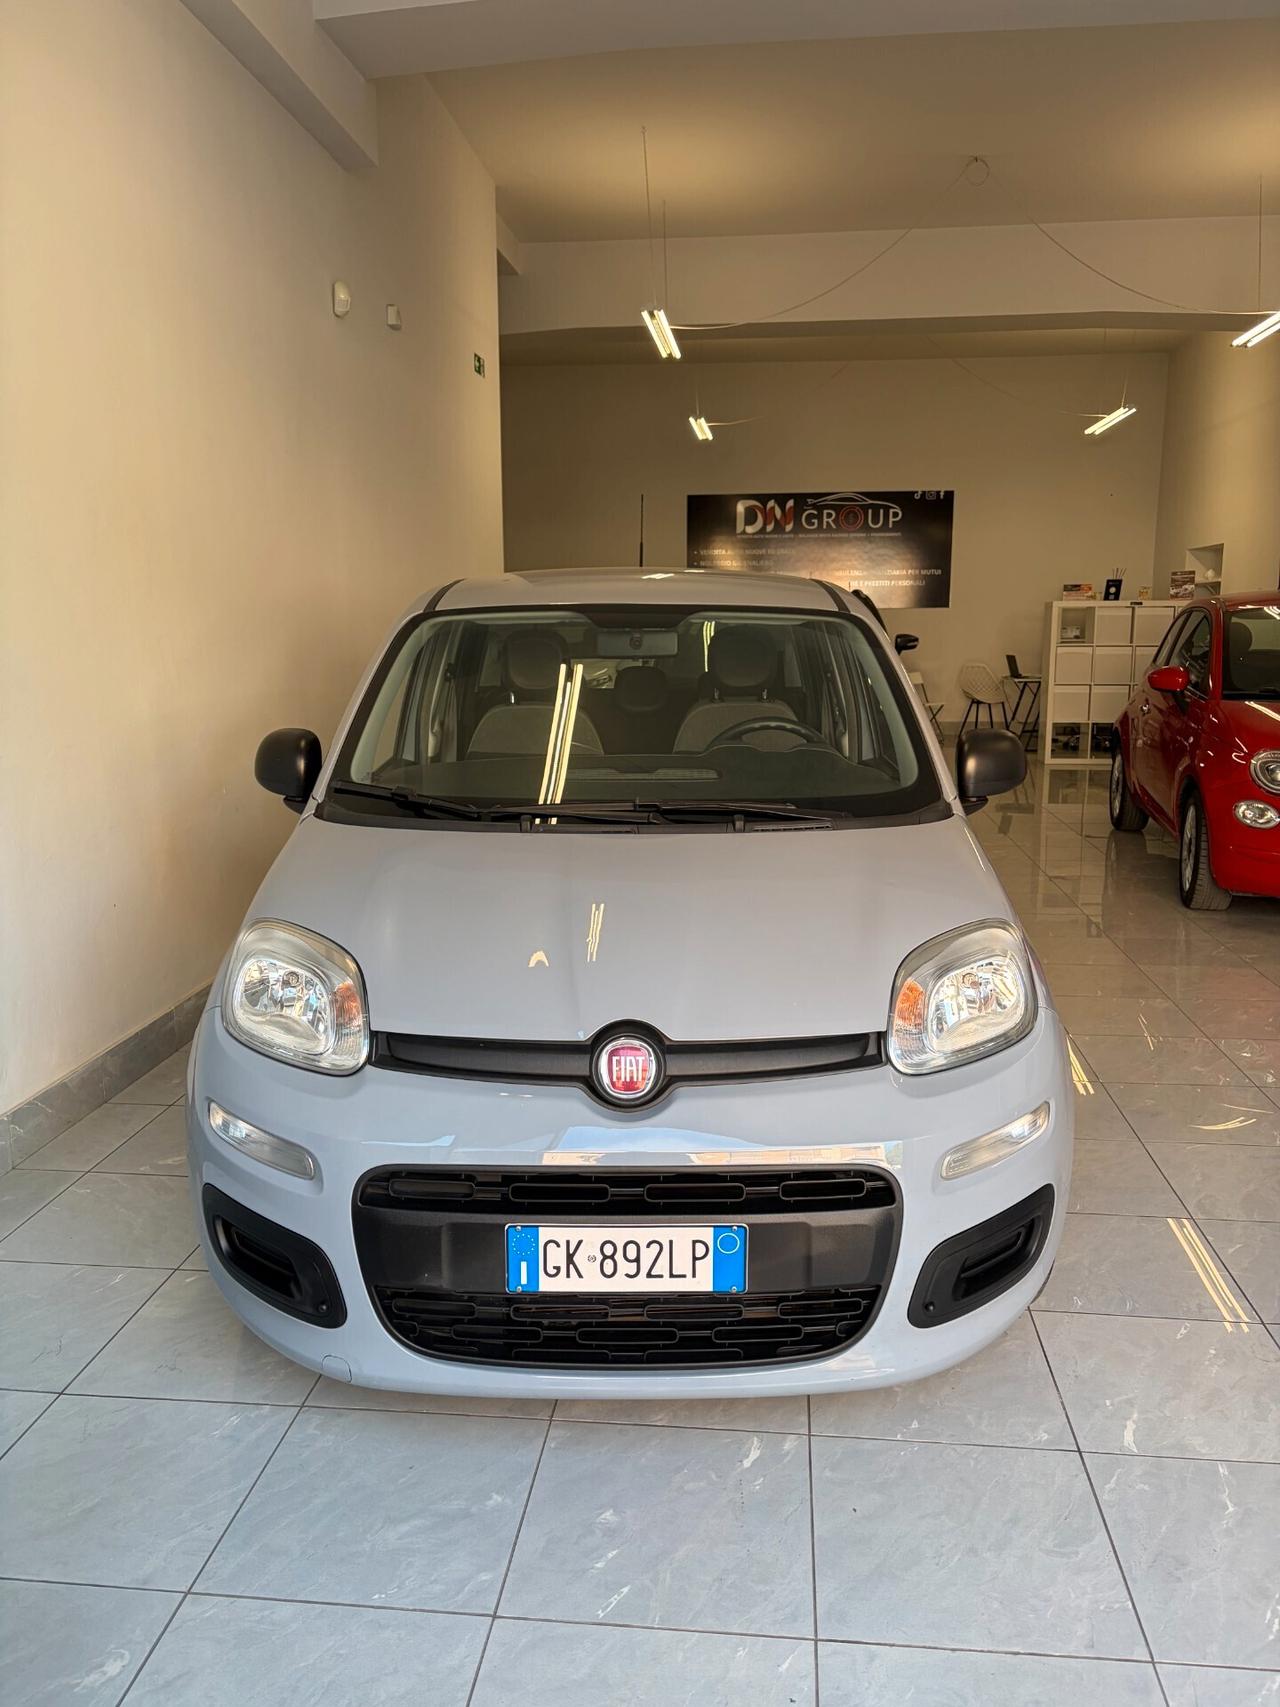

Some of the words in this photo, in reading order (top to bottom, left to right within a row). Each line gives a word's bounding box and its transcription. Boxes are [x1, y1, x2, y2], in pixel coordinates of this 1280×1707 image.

[736, 498, 795, 534] DN
[801, 505, 903, 531] GROUP
[612, 1056, 645, 1082] FIAT
